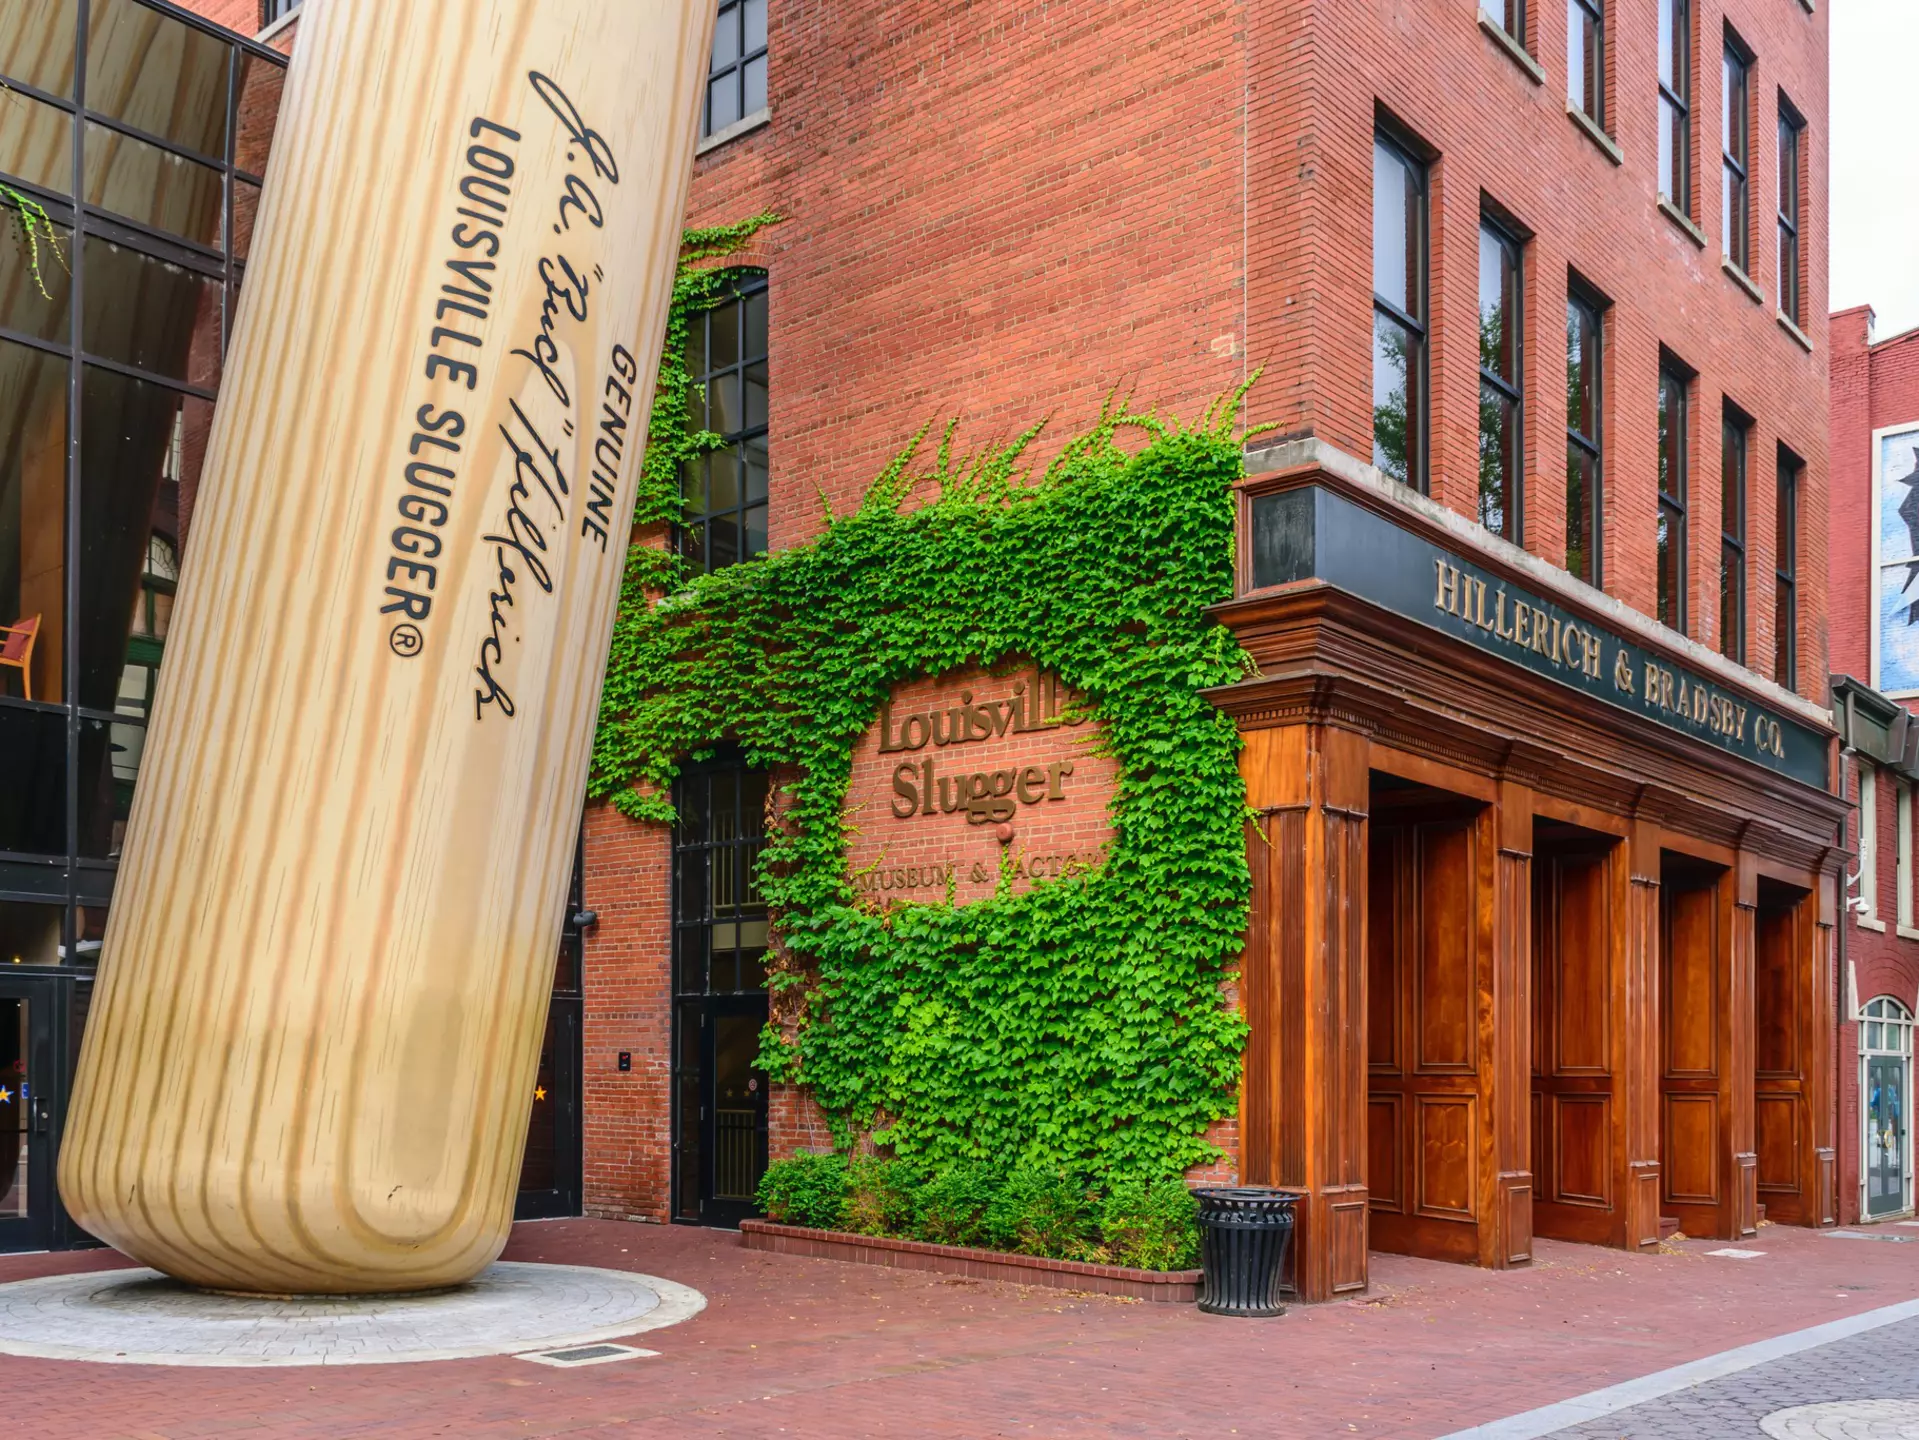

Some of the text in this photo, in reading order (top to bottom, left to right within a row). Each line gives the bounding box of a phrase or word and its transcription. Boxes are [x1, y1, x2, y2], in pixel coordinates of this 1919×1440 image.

[425, 116, 522, 391] LOUISVILLE
[581, 343, 637, 554] GENUINE
[474, 397, 570, 721] Hillerich
[1434, 559, 1785, 760] HILLERICH & BRADSBY CO.
[891, 757, 1075, 825] Slugger
[970, 861, 989, 883] &
[1001, 849, 1109, 880] ACTO
